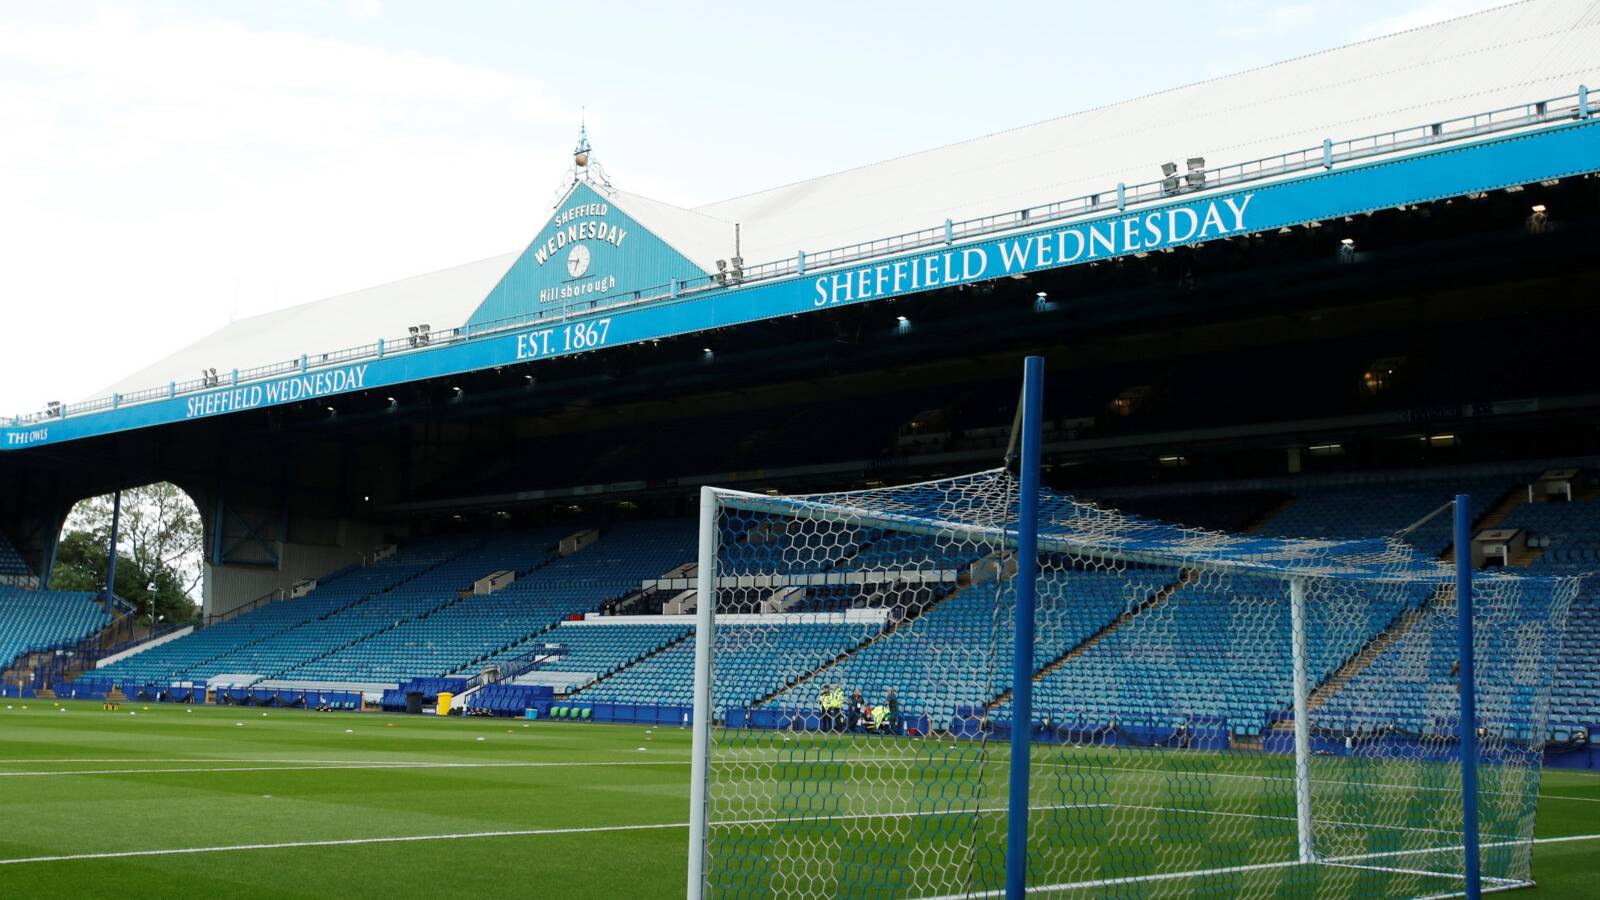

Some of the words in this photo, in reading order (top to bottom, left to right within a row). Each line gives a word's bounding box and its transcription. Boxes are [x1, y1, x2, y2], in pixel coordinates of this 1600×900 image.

[555, 203, 608, 227] SHEFFIELD
[534, 221, 627, 266] WEDNESDAY
[814, 248, 988, 307] SHEFFIELD
[998, 194, 1254, 274] WEDNESDAY
[540, 275, 616, 302] Hillsborough
[517, 329, 555, 360] EST.
[563, 318, 612, 351] 1867
[187, 386, 262, 418] SHEFFIELD
[266, 364, 368, 403] WEDNESDAY
[6, 432, 29, 444] THE
[29, 429, 48, 443] OWLS
